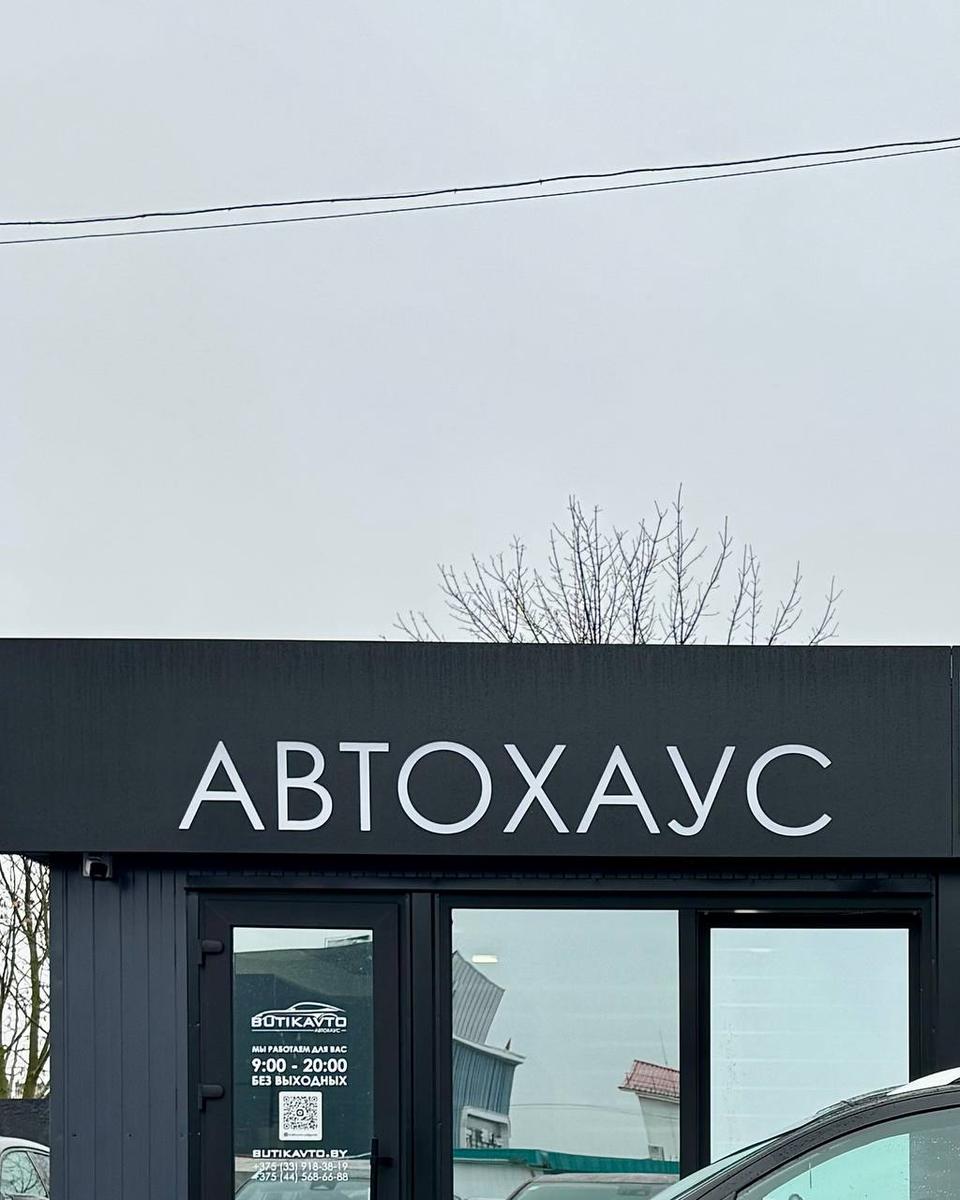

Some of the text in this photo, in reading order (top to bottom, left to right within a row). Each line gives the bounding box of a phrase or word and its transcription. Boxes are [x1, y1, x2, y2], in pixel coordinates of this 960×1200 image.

[179, 741, 832, 836] АВТОХАУС
[251, 1016, 347, 1028] BUTIKAVTO
[311, 1046, 329, 1054] ДЛЯ
[252, 1058, 286, 1072] 9:00
[303, 1058, 348, 1072] 20:00
[252, 1076, 348, 1087] БЕЗ ВЫХОДНЫХ
[252, 1149, 348, 1158] BUTIKAVTO.BY
[254, 1162, 348, 1173] +375 (33) 918-38-19
[280, 1172, 298, 1183] (44)
[301, 1172, 348, 1181] 568-66-88
